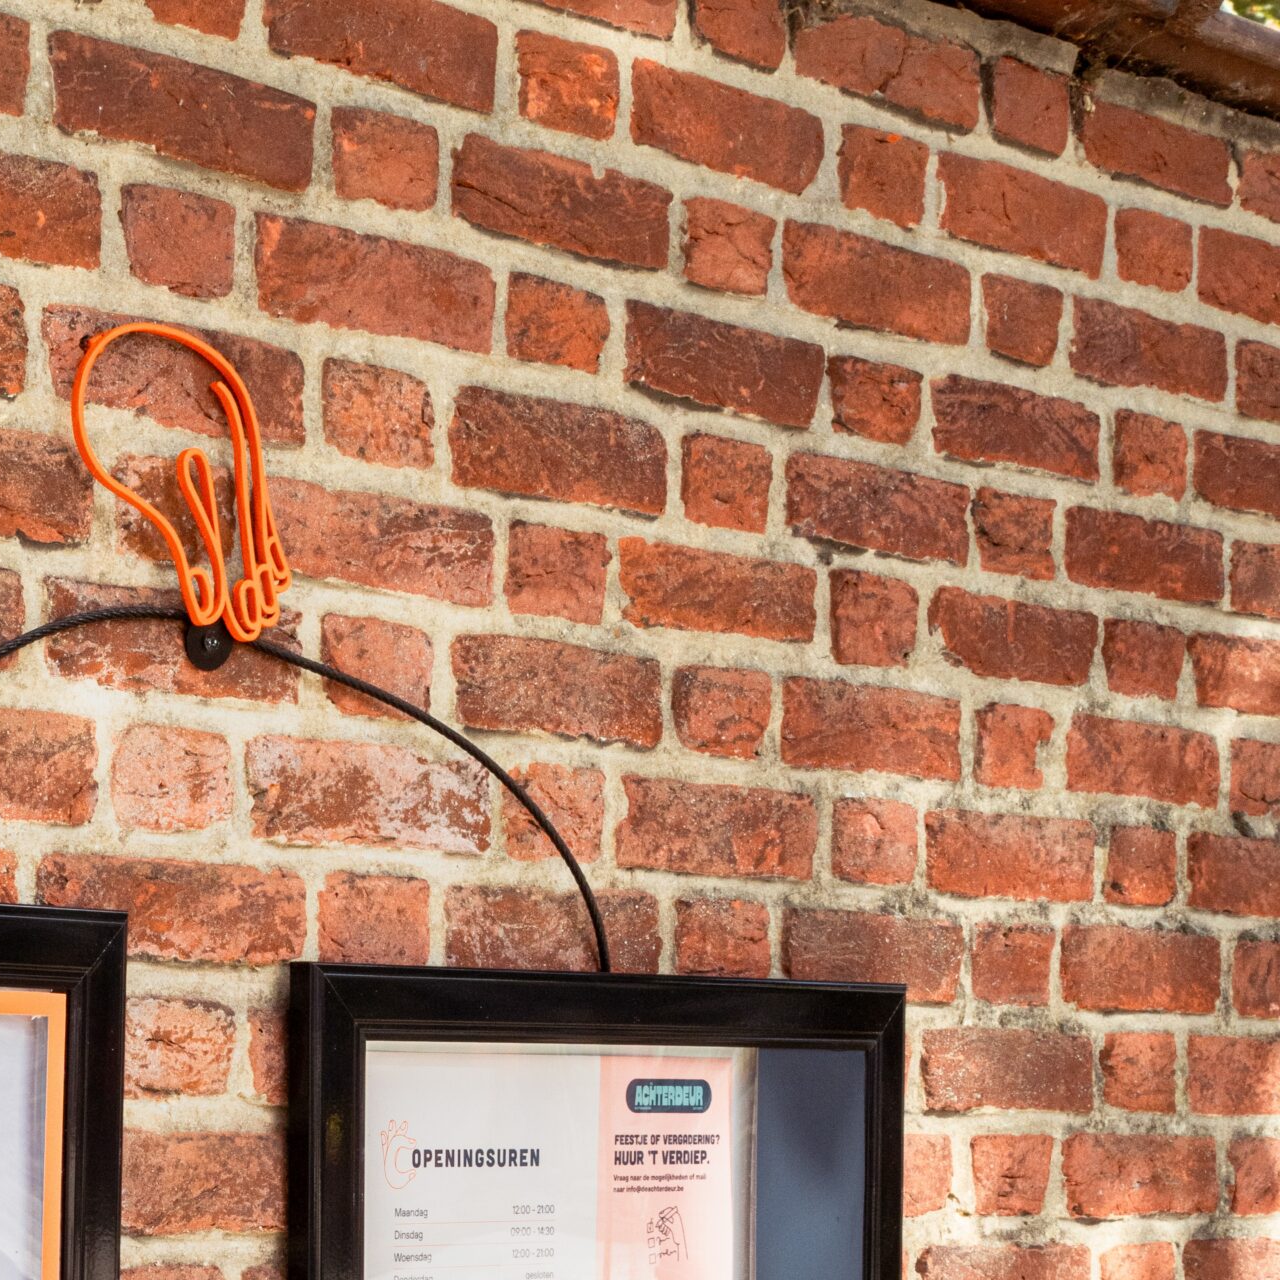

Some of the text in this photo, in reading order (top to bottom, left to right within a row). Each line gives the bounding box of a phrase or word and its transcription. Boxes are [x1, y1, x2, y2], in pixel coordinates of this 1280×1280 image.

[635, 1085, 703, 1106] ACHTERDEUR
[615, 1134, 720, 1145] FEESTJE OF VERGADERING?
[412, 1148, 540, 1168] OPENINGSUREN
[614, 1151, 709, 1165] HUUR 'T VERDIEP.
[395, 1205, 555, 1218] Maandag 12:00 21:00
[394, 1230, 423, 1241] Dinsdag
[511, 1227, 531, 1236] 09:00
[394, 1253, 432, 1263] Woensdag
[526, 1271, 554, 1280] gesloten
